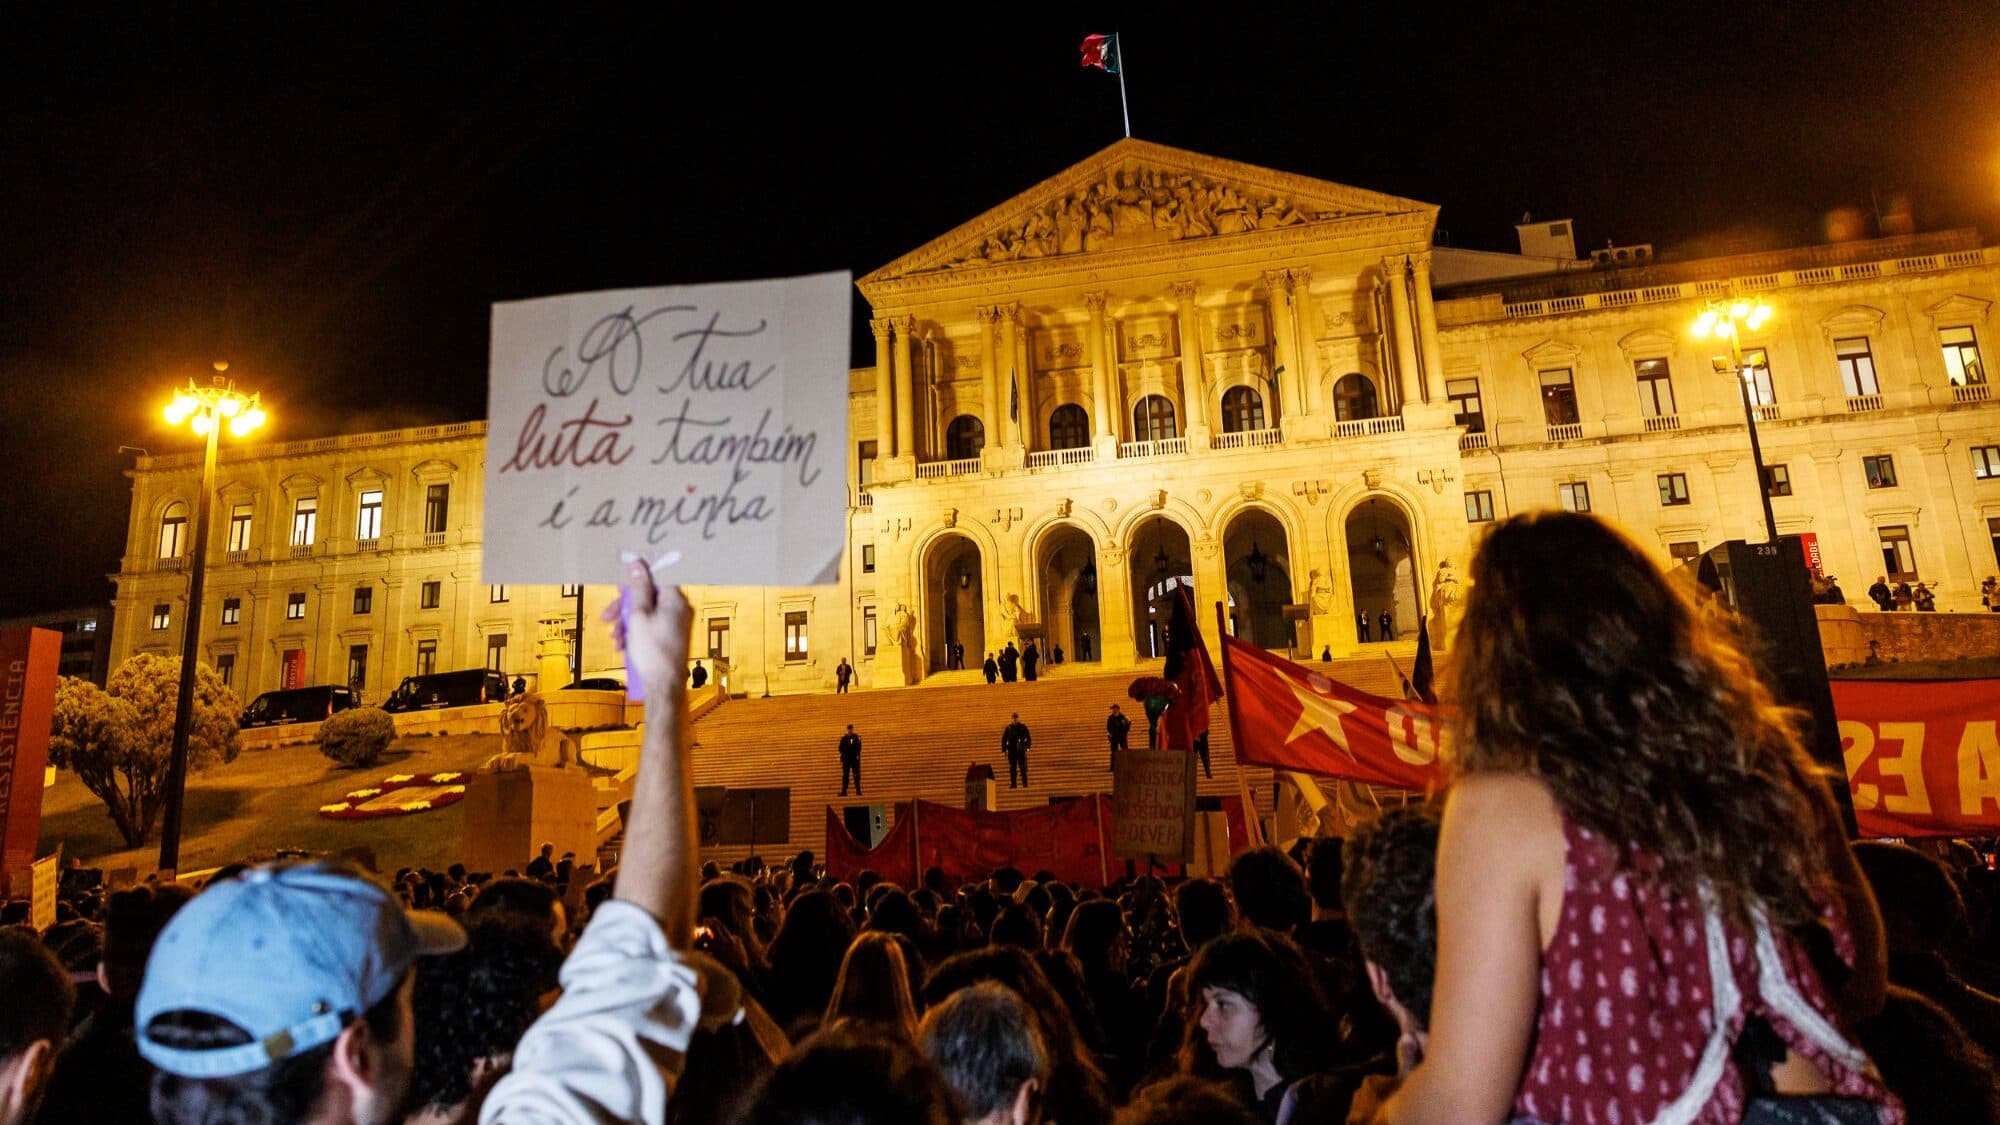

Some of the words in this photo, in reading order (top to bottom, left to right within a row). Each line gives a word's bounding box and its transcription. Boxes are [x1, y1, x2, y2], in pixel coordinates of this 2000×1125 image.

[658, 312, 776, 393] tua
[500, 399, 634, 473] luta
[652, 399, 822, 486] também
[586, 495, 619, 528] a
[631, 478, 774, 545] minha
